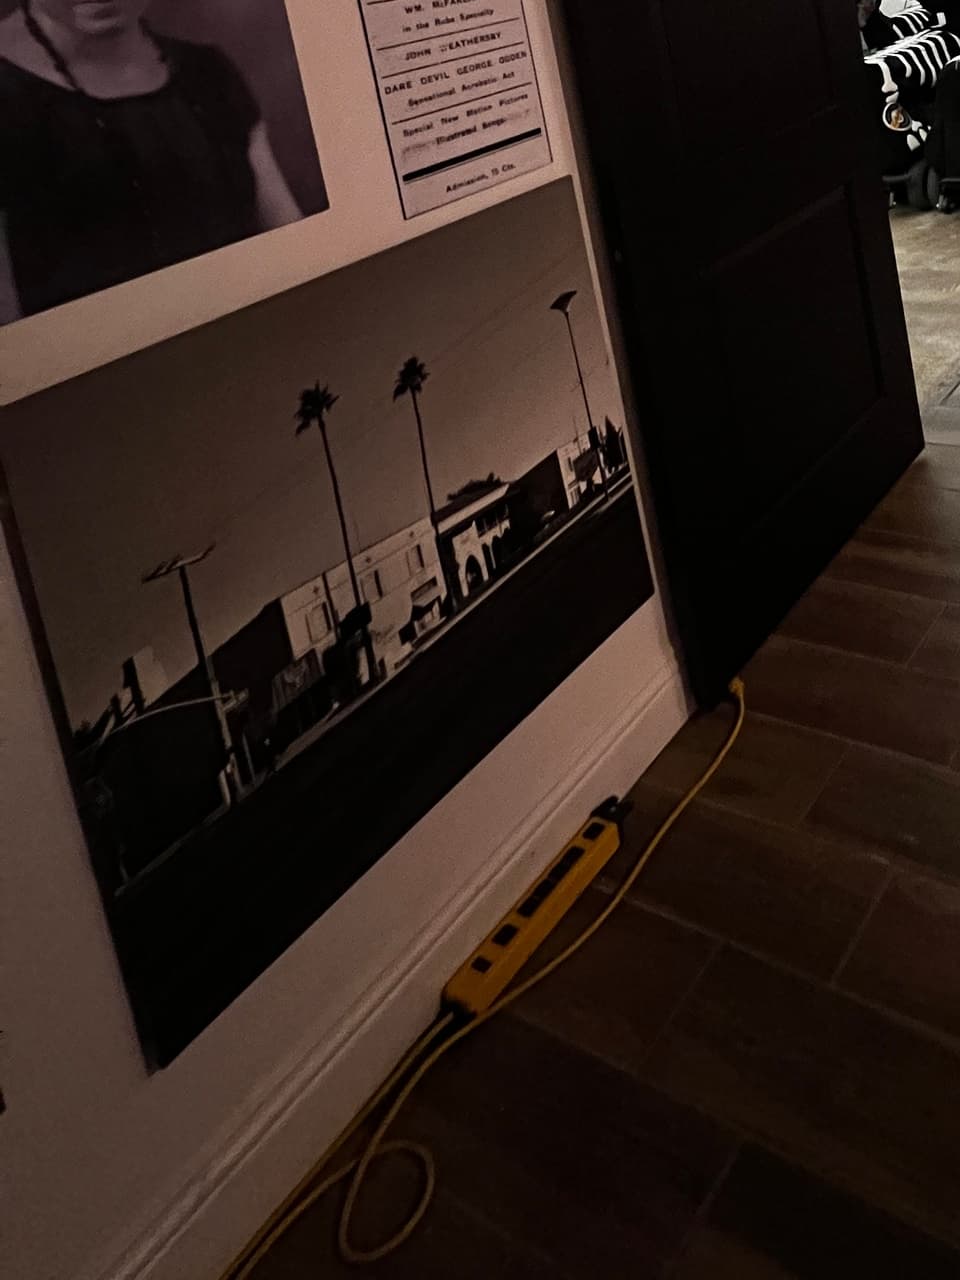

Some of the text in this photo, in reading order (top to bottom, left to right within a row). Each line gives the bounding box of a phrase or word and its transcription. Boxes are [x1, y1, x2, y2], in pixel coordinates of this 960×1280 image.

[416, 21, 430, 30] the
[405, 48, 431, 61] JOHN
[384, 80, 413, 95] DARE
[420, 72, 450, 86] DEVIL
[456, 60, 492, 76] GEORGE
[502, 71, 516, 81] Act
